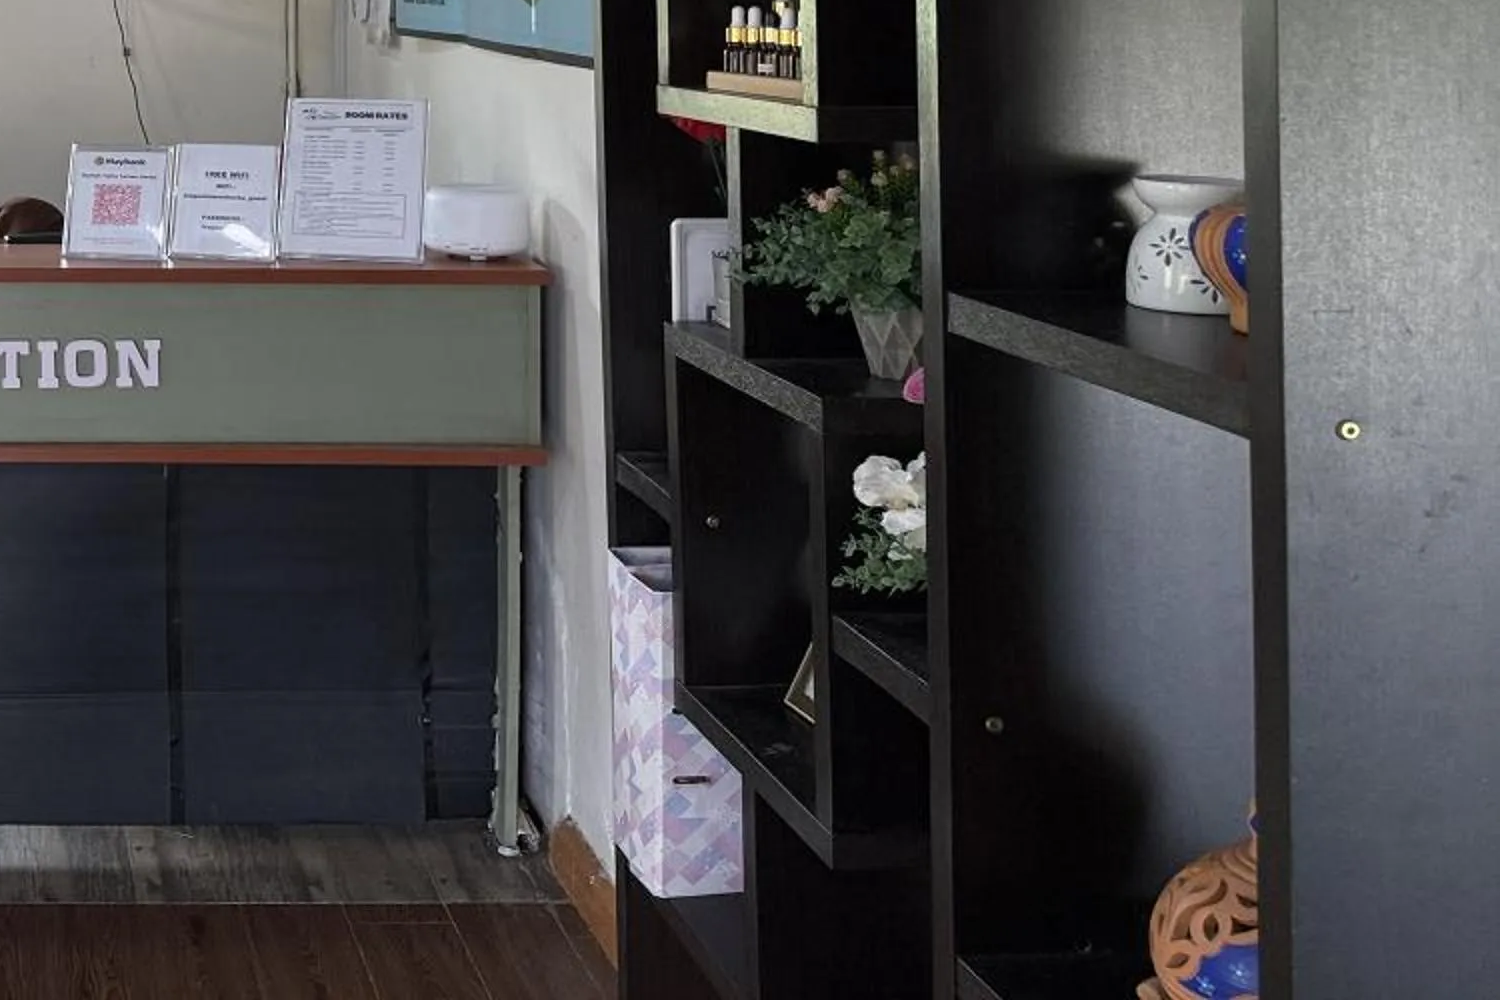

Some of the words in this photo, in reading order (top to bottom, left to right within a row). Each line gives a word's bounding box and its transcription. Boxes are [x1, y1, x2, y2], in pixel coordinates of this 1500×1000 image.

[344, 111, 375, 120] ROOM
[375, 111, 409, 121] RATES
[105, 157, 148, 167] Maybank
